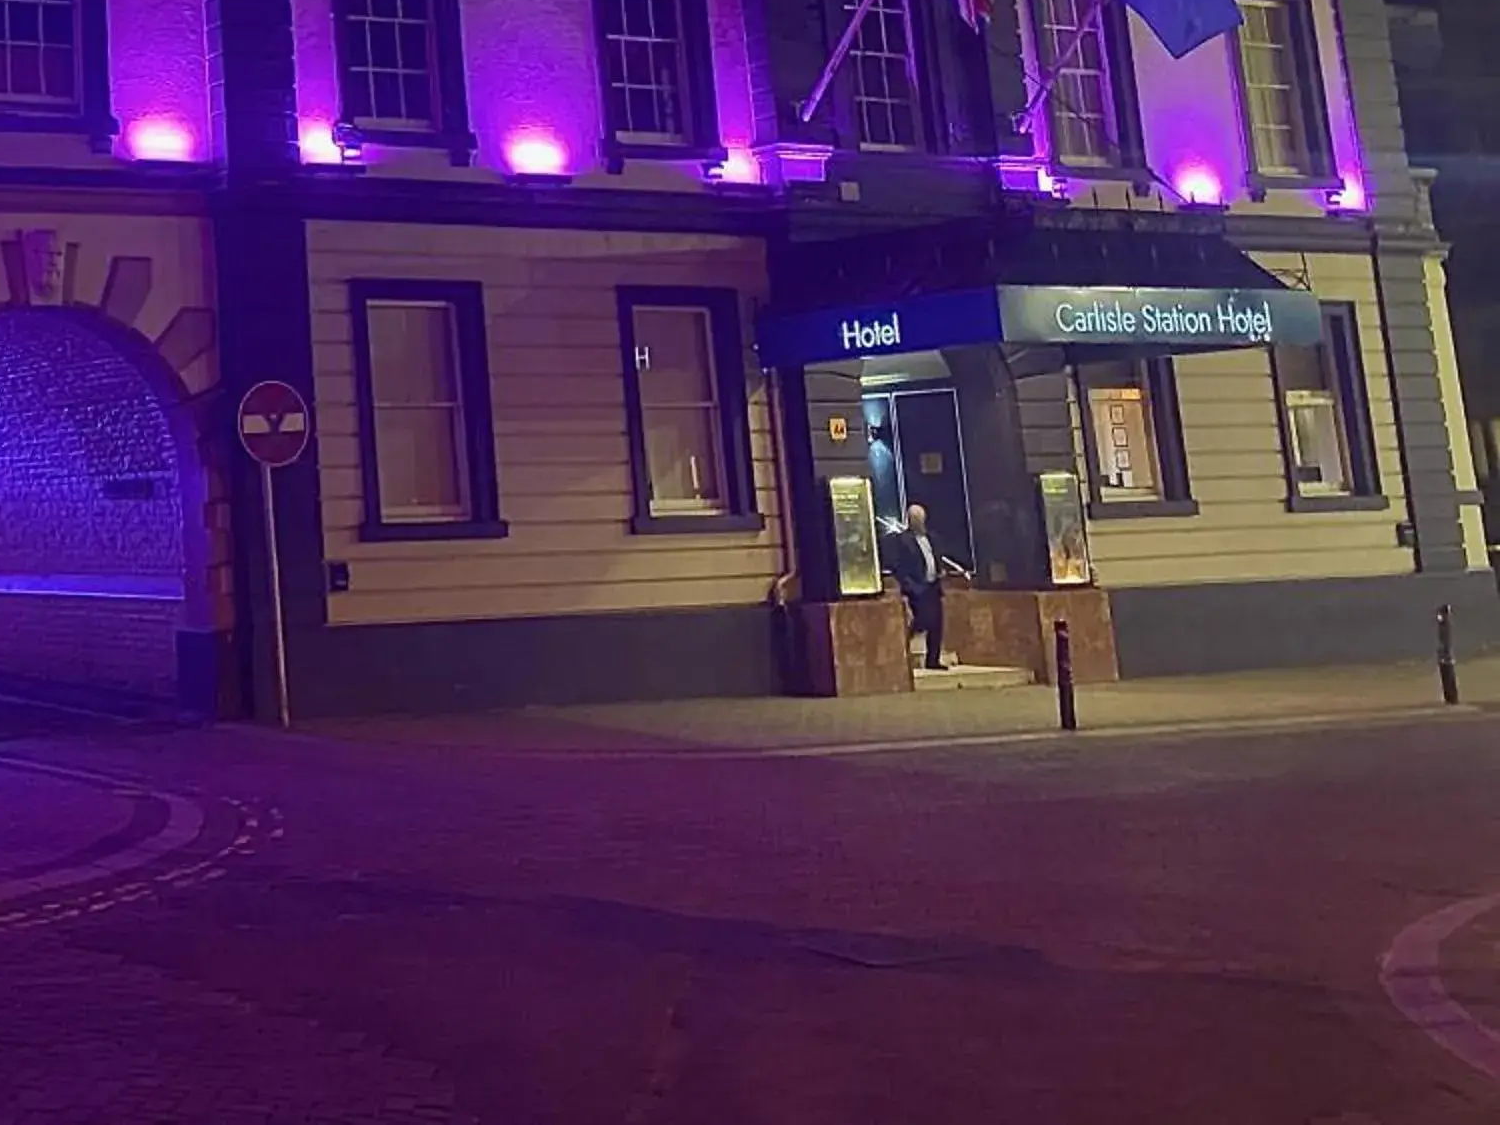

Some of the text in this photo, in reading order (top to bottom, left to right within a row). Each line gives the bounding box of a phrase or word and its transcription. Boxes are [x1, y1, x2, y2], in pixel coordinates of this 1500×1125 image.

[842, 311, 901, 350] Hotel
[1055, 300, 1273, 334] Carlisle Station Hotel
